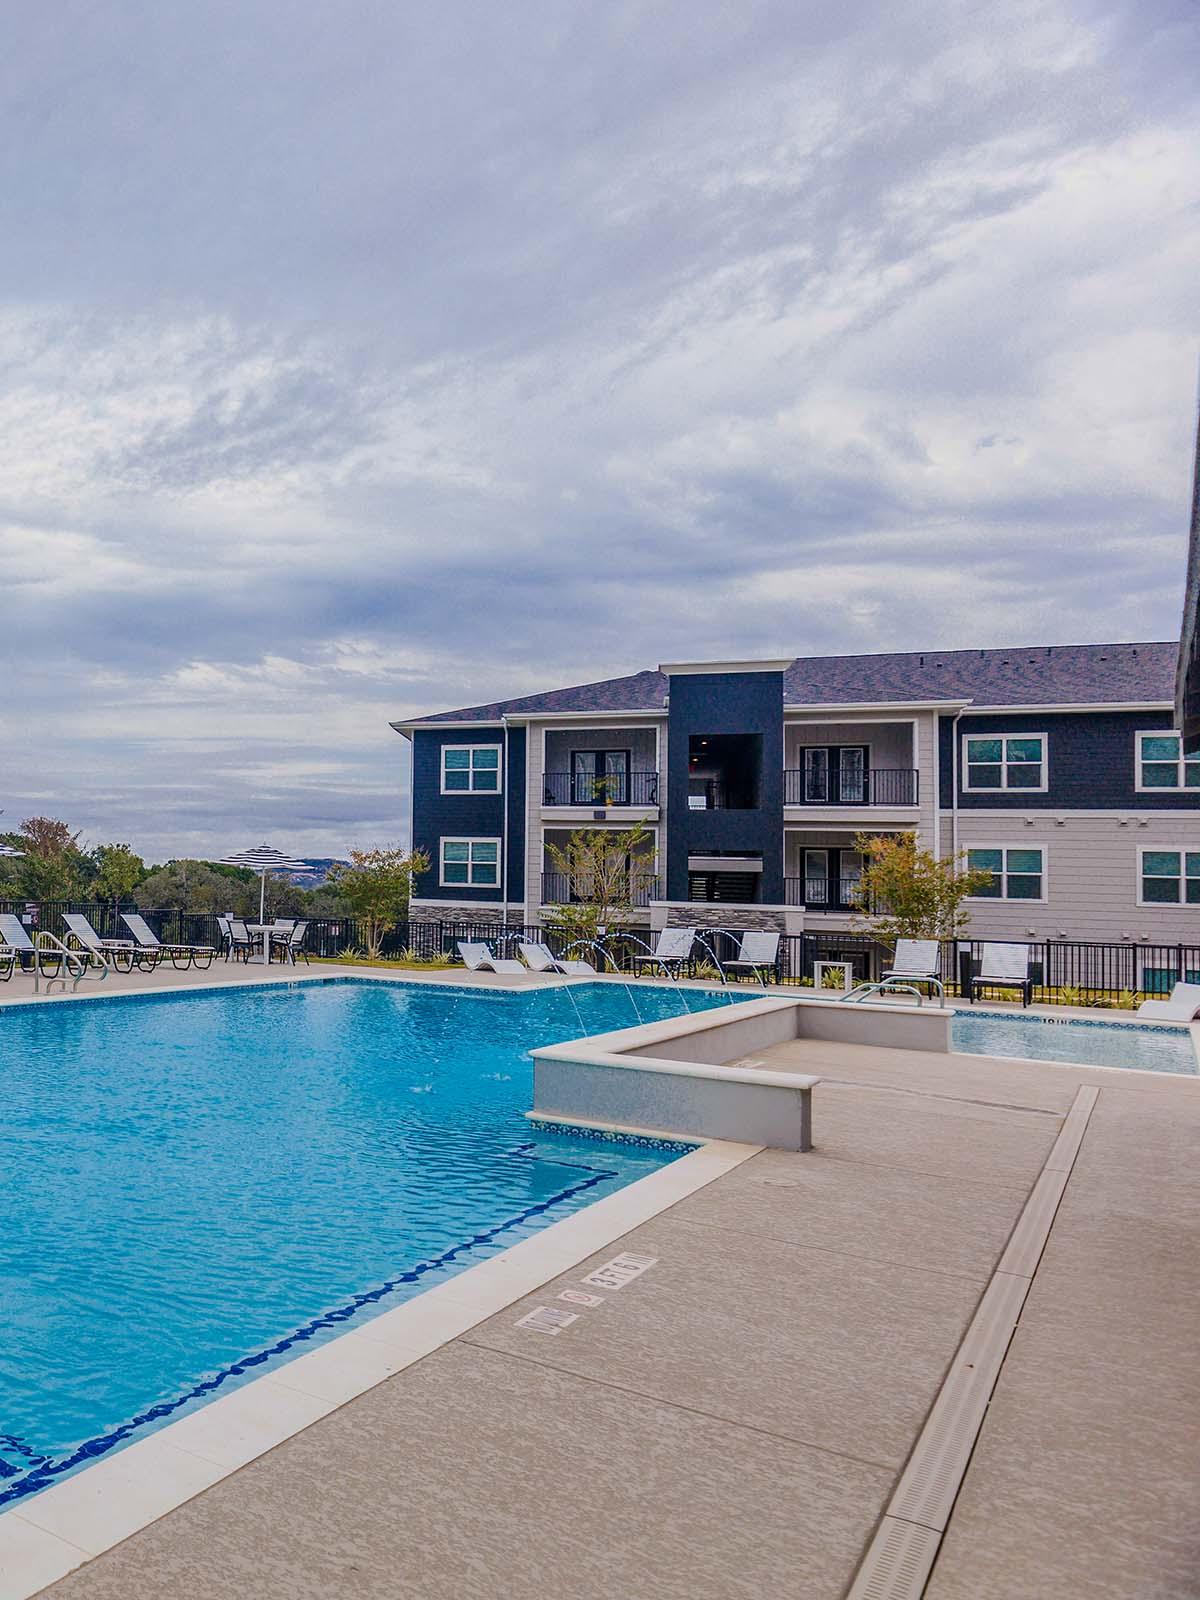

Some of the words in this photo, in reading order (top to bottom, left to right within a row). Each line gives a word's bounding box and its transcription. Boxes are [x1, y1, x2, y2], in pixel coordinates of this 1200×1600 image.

[613, 1262, 641, 1271] 6
[598, 1268, 630, 1281] FT
[590, 1277, 617, 1286] 3
